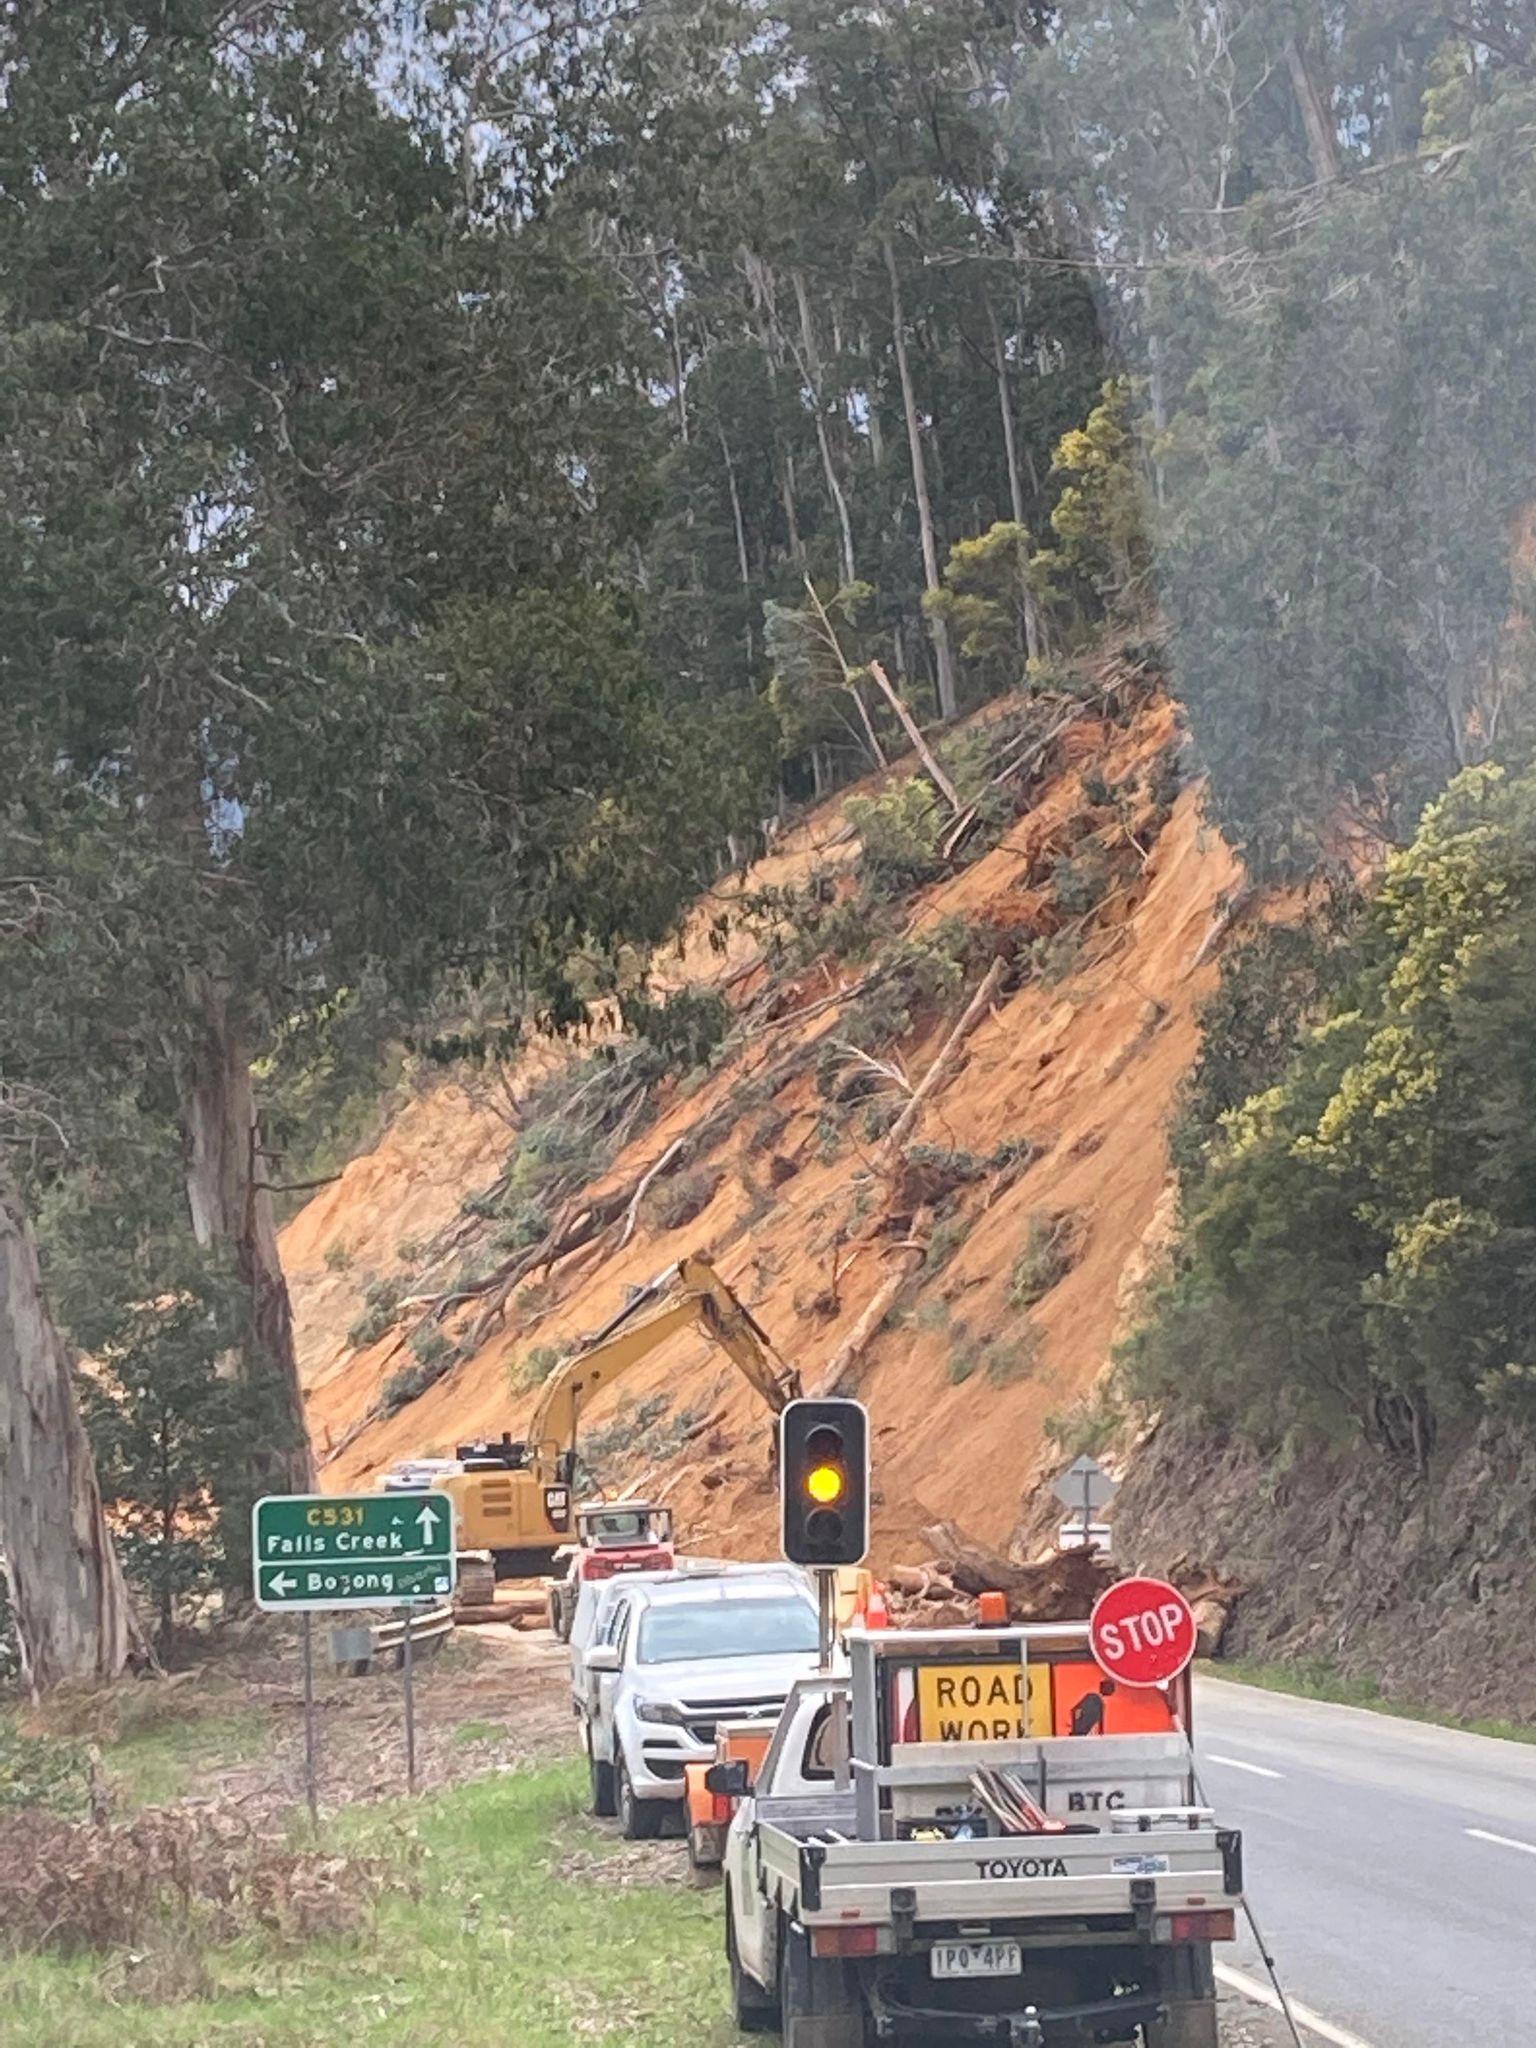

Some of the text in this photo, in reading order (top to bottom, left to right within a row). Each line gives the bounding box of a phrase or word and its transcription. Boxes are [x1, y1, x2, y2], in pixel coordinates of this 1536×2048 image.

[306, 1508, 364, 1527] C531
[267, 1532, 403, 1554] Falls Creek
[1100, 1603, 1183, 1660] STOP
[937, 1674, 1033, 1708] ROAD
[1068, 1791, 1124, 1811] BTC
[976, 1858, 1068, 1880] TOYOTA
